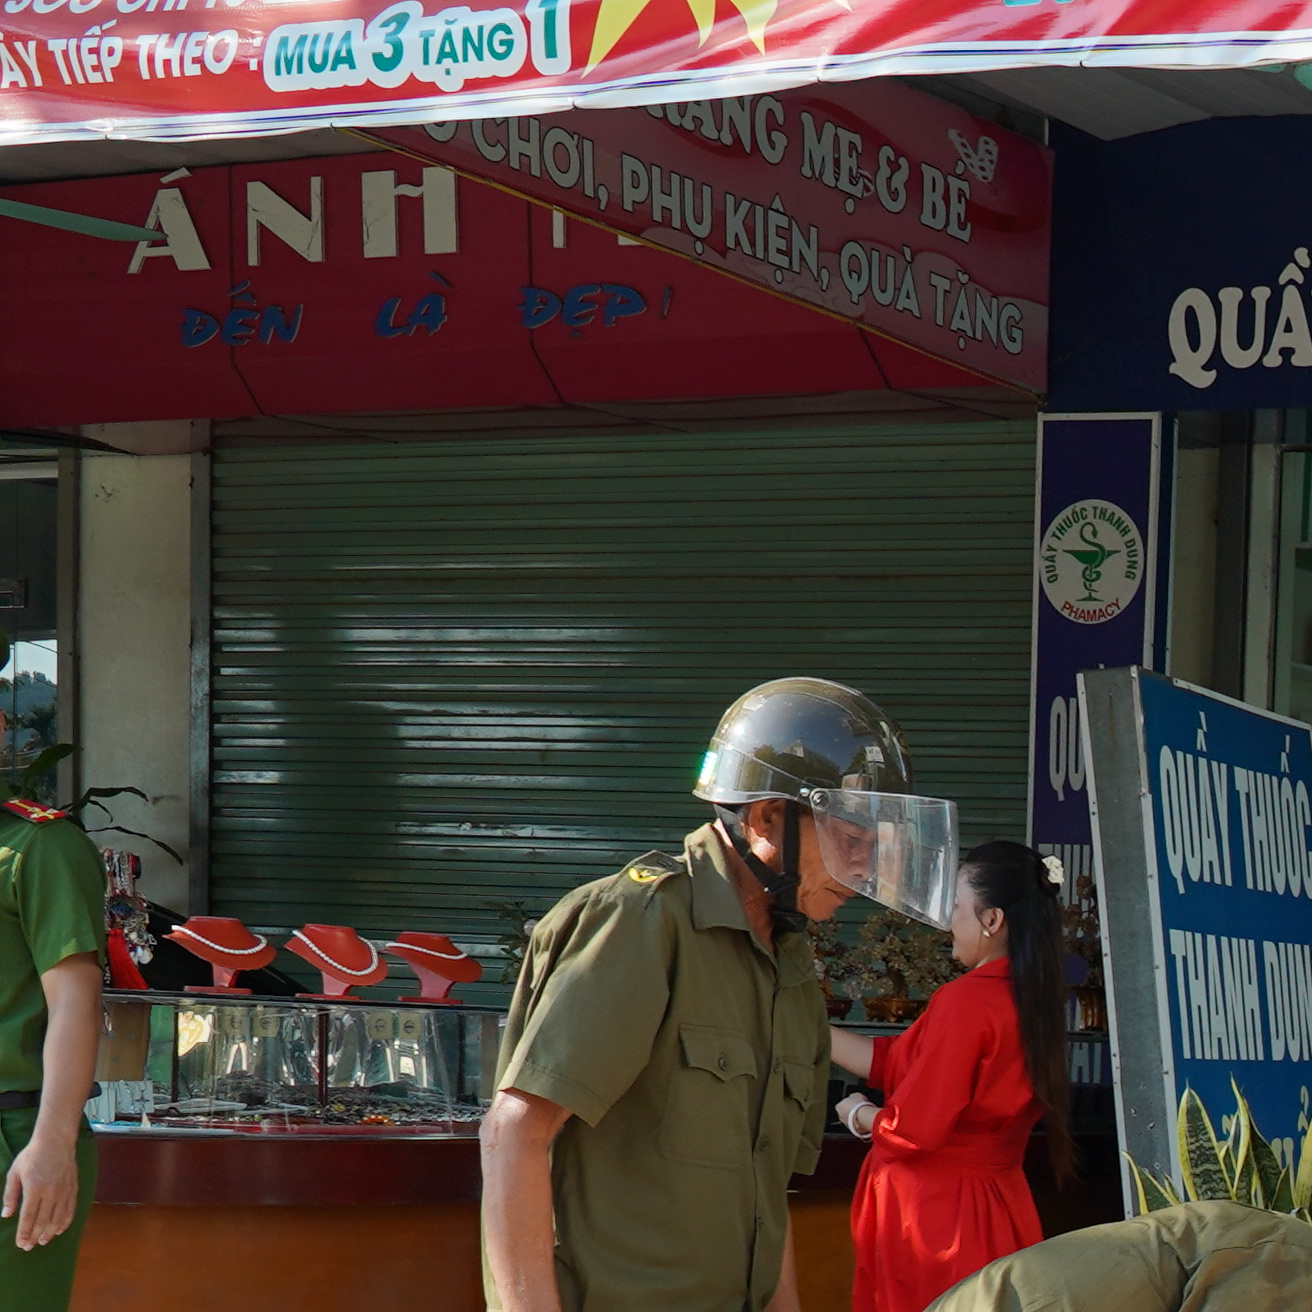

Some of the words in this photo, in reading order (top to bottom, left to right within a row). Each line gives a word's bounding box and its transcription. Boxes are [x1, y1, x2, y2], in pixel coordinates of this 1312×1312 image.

[48, 19, 123, 85] TIẾP
[136, 29, 239, 80] THEO
[275, 34, 357, 76] MUA
[371, 11, 410, 70] 3
[419, 11, 514, 76] TẶNG
[541, 0, 562, 59] 1
[646, 96, 789, 166] ANG
[799, 111, 869, 214] MẸ
[875, 146, 911, 213] &
[920, 162, 973, 244] BÉ
[470, 116, 609, 212] CHƠI,
[620, 151, 713, 256] PHỤ
[724, 192, 831, 292] KIỆN,
[839, 242, 920, 320] QUÀ
[930, 259, 1024, 356] TẶNG
[179, 279, 304, 349] ĐẾN
[374, 271, 450, 338] LÀ
[520, 284, 648, 340] ĐẸP
[1092, 505, 1131, 538] THANH
[1124, 537, 1139, 581] DUNG
[1061, 598, 1121, 622] PHAMACY
[1049, 695, 1088, 802] QU
[1159, 711, 1232, 895] QUẦY
[1170, 929, 1264, 1062] THANH
